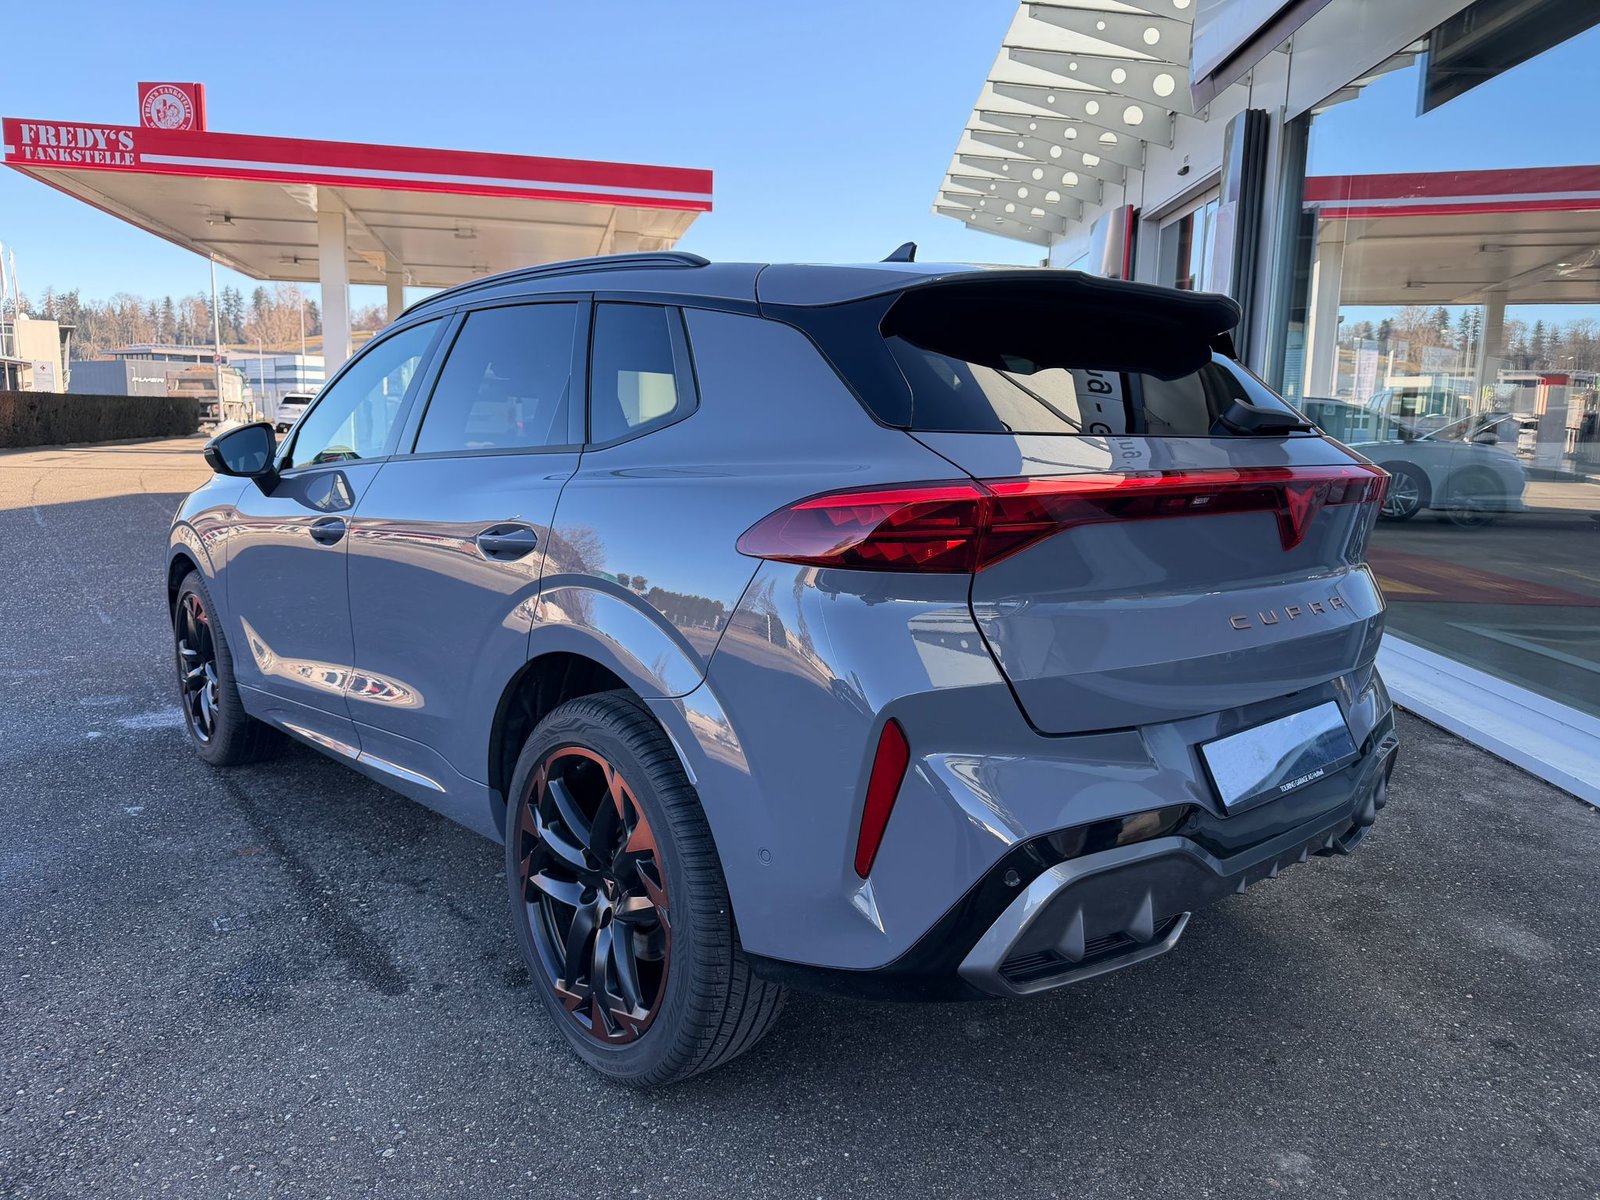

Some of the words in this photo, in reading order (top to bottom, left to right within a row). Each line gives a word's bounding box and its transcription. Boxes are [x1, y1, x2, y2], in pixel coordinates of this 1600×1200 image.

[20, 123, 134, 151] FREDY'S
[22, 146, 135, 165] TANKSTELLE
[1229, 597, 1344, 630] CUPRA
